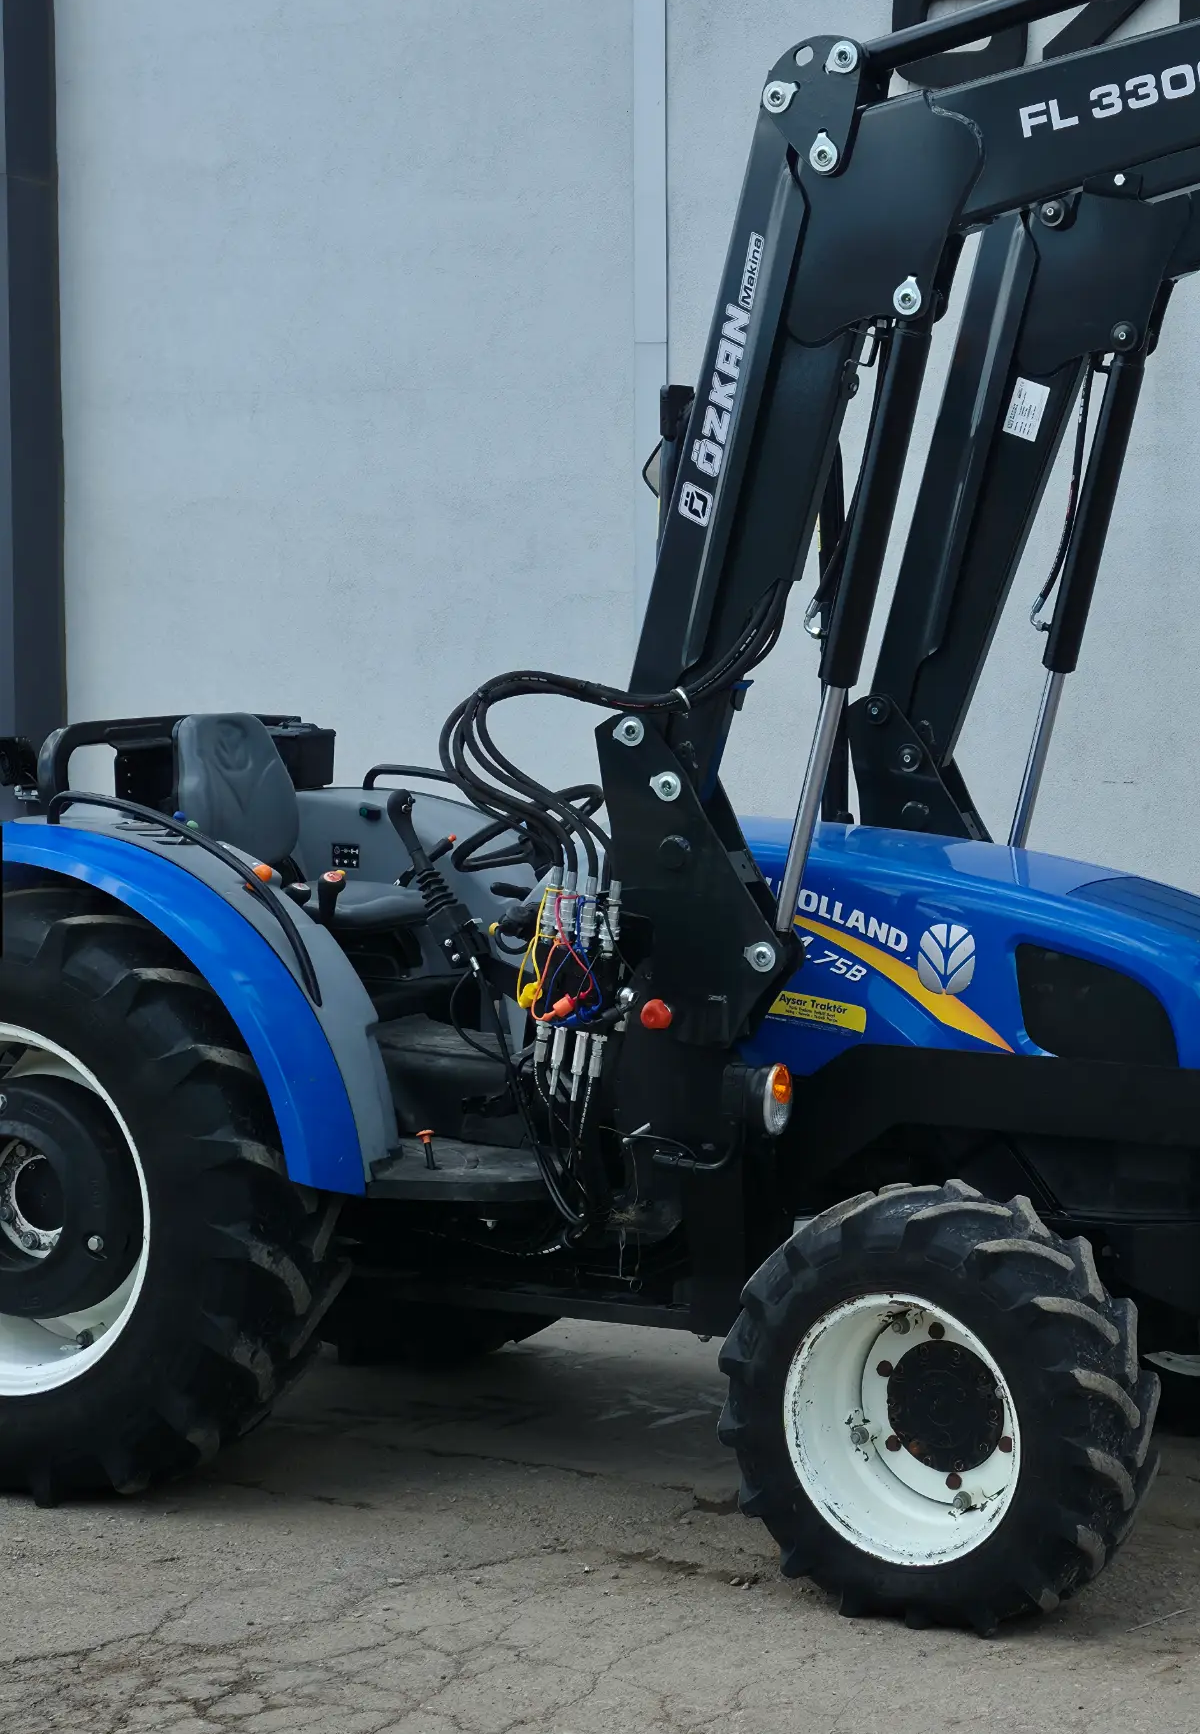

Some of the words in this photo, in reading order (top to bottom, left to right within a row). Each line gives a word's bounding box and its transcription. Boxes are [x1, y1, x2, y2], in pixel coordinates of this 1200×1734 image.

[1019, 99, 1079, 138] FL
[691, 303, 750, 478] ÖZKAN
[741, 236, 763, 307] Makina
[777, 880, 908, 953] OLLAND
[779, 993, 807, 1006] Aysar
